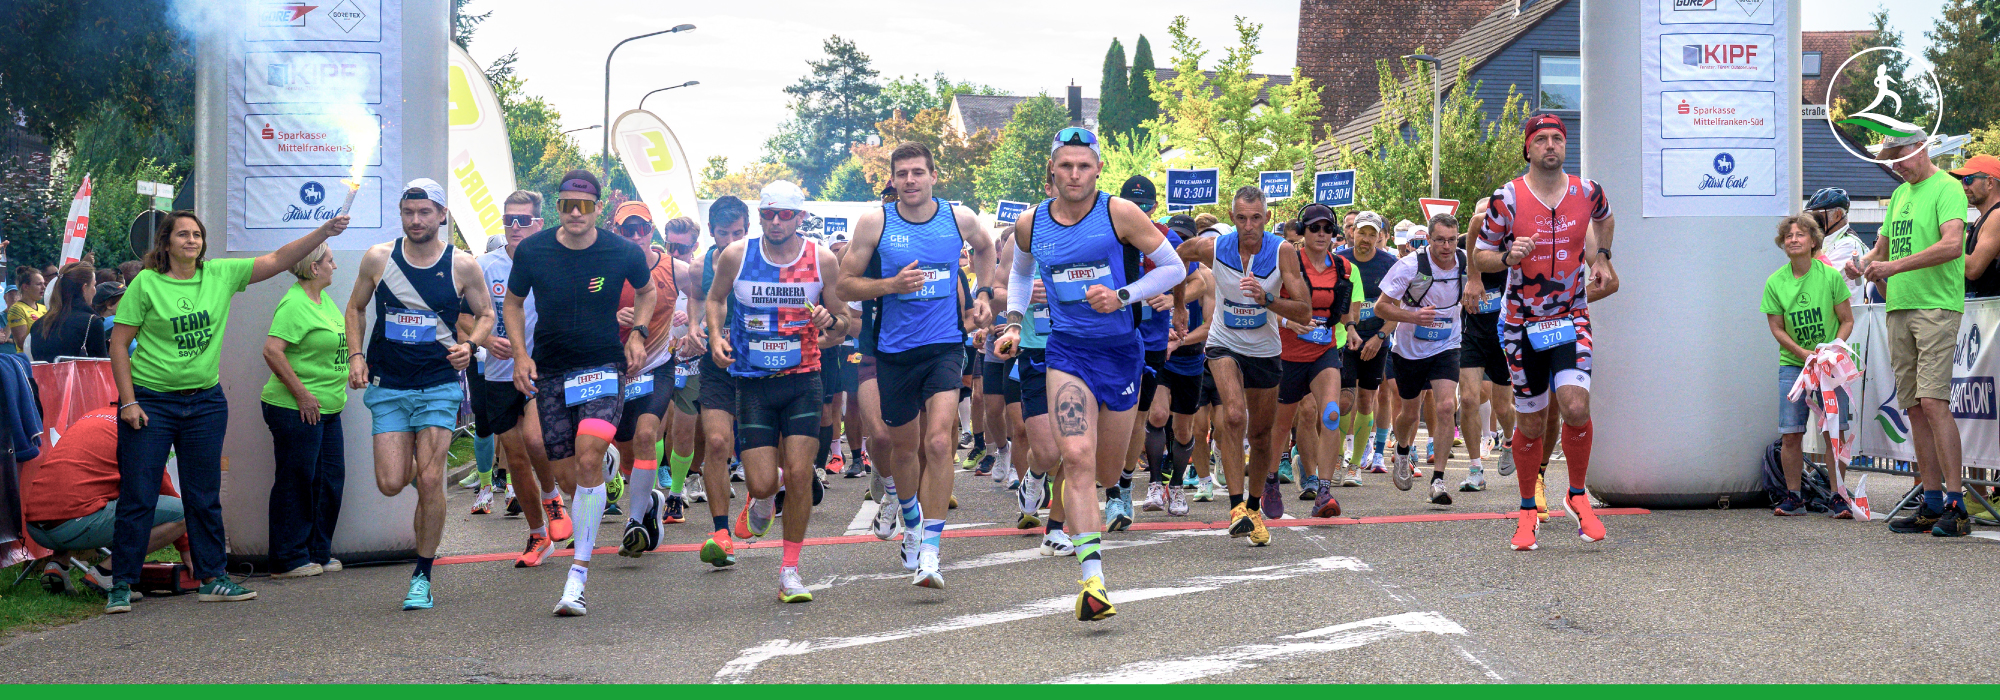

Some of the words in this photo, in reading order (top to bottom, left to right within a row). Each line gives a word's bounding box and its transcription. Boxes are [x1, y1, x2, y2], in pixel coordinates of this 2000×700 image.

[1704, 44, 1758, 64] KIPF
[1693, 106, 1736, 116] Sparkasse
[1693, 117, 1764, 126] Mittelfranken-Süd
[278, 131, 327, 142] Sparkasse
[1726, 174, 1749, 189] Carl
[1173, 187, 1182, 198] M
[1184, 187, 1204, 199] 3:30
[1205, 186, 1213, 198] H
[1263, 185, 1270, 193] M
[1270, 185, 1284, 194] 3:45
[1283, 184, 1289, 193] H
[1319, 190, 1327, 201] M
[1327, 188, 1344, 200] 3:30
[1344, 187, 1351, 199] H
[1892, 218, 1913, 237] TEAM
[890, 234, 909, 243] GEH
[1892, 236, 1911, 255] 2025
[751, 285, 762, 296] LA
[765, 286, 806, 297] CARRERA
[779, 297, 806, 305] ROTHSEE
[1479, 302, 1493, 311] 187
[1360, 310, 1371, 318] 79
[1789, 306, 1823, 327] TEAM
[169, 309, 210, 334] TEAM
[1235, 317, 1255, 326] 236
[402, 328, 417, 340] 44
[1312, 331, 1324, 340] 82
[1428, 330, 1439, 339] 83
[1542, 331, 1562, 345] 370
[1794, 323, 1826, 341] 2025
[174, 328, 213, 351] 2025
[337, 332, 346, 348] TE
[334, 348, 349, 365] 202
[764, 355, 787, 366] 355
[675, 377, 680, 386] 6
[580, 384, 602, 399] 252
[624, 385, 642, 398] 349
